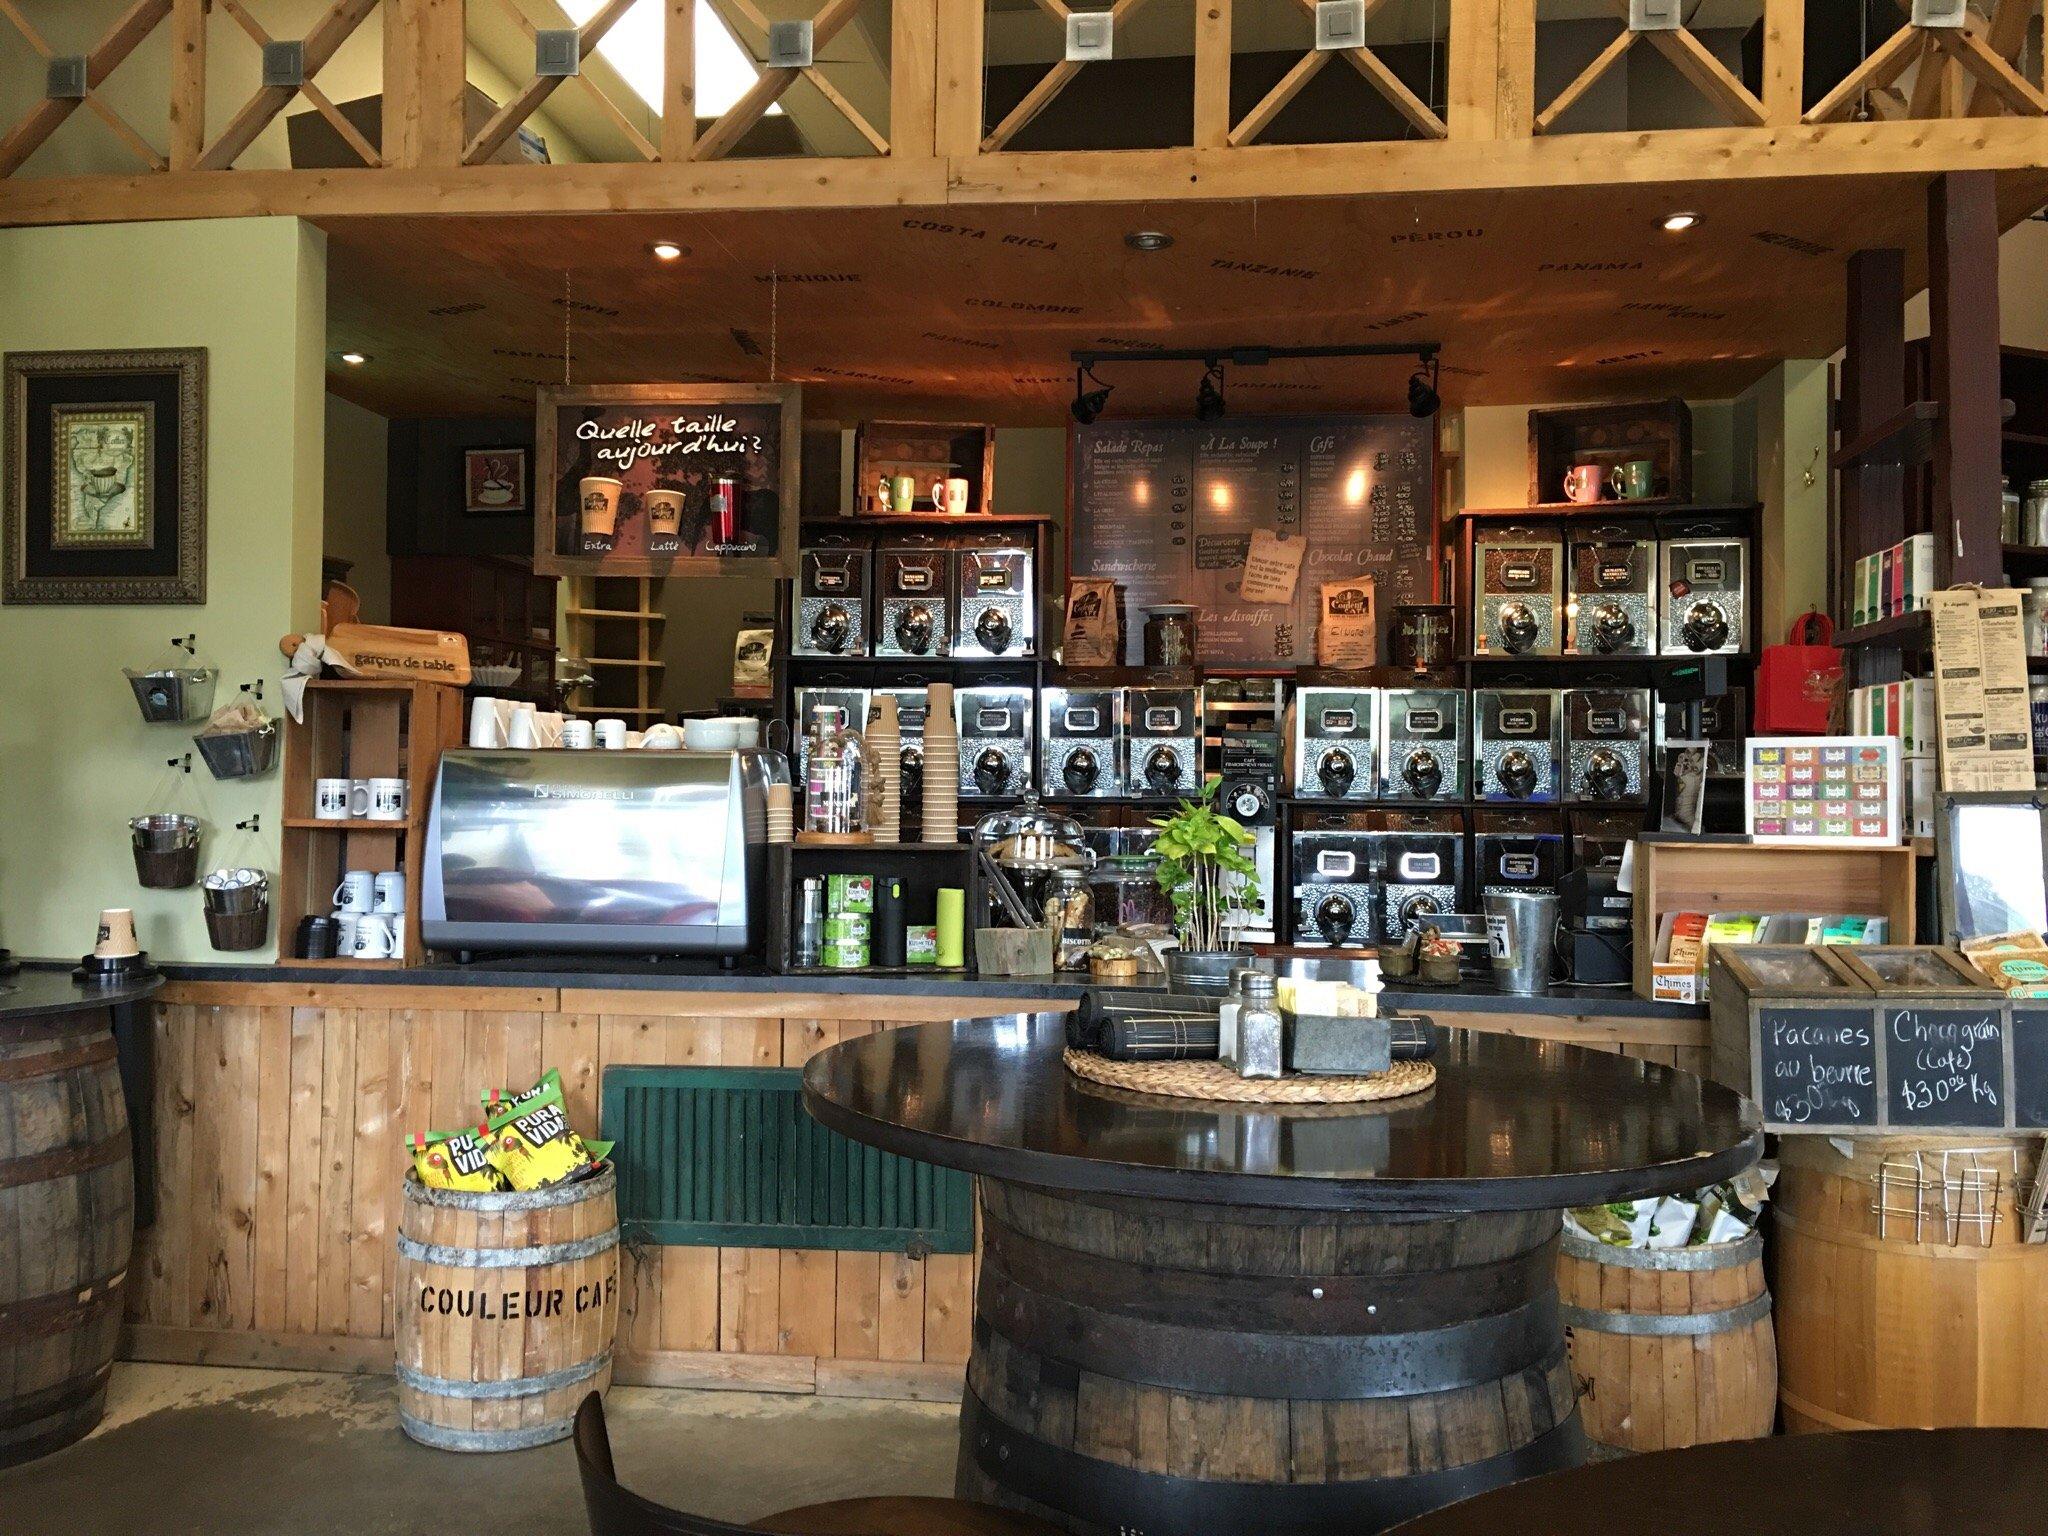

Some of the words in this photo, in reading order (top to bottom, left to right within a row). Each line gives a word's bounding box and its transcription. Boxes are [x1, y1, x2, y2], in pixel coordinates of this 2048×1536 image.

[902, 219, 988, 241] COSTA
[1001, 232, 1059, 250] RICA
[1209, 257, 1321, 280] TANZANIE
[1538, 261, 1643, 271] PANAMA
[963, 298, 1084, 314] COLOMBIE
[811, 365, 915, 385] NICARAGUA
[576, 418, 657, 441] Quelle
[671, 414, 737, 434] taille
[1093, 440, 1128, 454] Salade
[1131, 439, 1164, 457] Repas
[1218, 437, 1235, 450] La
[1239, 436, 1269, 455] Soupe
[1310, 435, 1335, 454] Café
[584, 540, 612, 551] Extra
[705, 540, 757, 553] Cappuccino
[1091, 558, 1157, 572] Sandwicherie
[1308, 548, 1354, 566] Chocolat
[1357, 548, 1394, 566] Chaud
[1197, 609, 1218, 623] Les
[354, 654, 400, 669] garçon
[404, 656, 420, 668] de
[423, 659, 455, 671] table
[552, 789, 634, 800] SIMONELLI
[1655, 974, 1692, 990] Chimes
[1775, 1059, 1801, 1078] au
[1809, 1054, 1873, 1086] beurre
[515, 1104, 565, 1132] PURA
[420, 1285, 562, 1320] COULEUR
